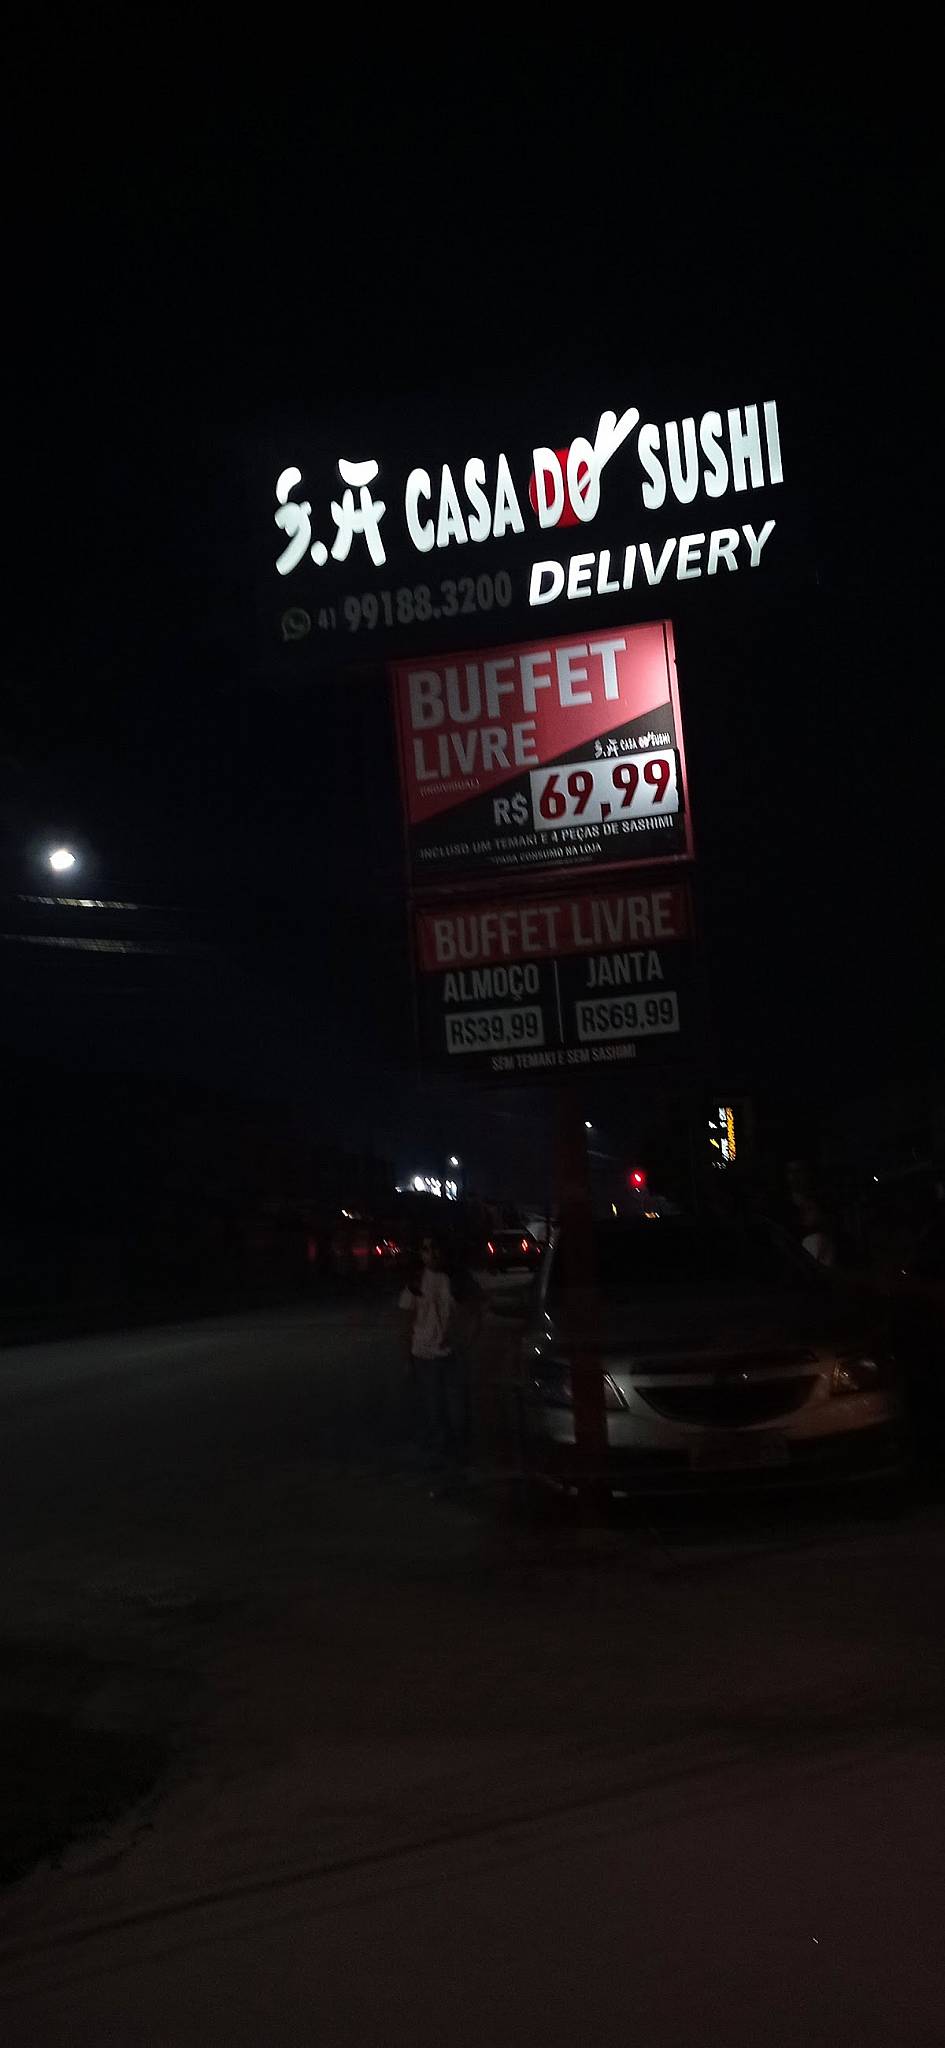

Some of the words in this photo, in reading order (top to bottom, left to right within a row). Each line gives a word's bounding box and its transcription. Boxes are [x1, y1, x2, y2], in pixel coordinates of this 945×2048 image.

[405, 452, 525, 552] CASA
[533, 430, 608, 528] DO
[636, 400, 784, 510] SUSHI
[528, 518, 777, 606] DELIVERY
[343, 570, 512, 632] 99188.3200
[408, 638, 627, 730] BUFFET
[413, 719, 540, 780] LIVRE
[492, 792, 529, 826] R$
[540, 759, 671, 821] 69,99
[540, 831, 548, 845] E
[603, 822, 621, 836] DE
[622, 814, 674, 833] SASHIMI
[433, 907, 560, 962] BUFFET
[571, 891, 676, 948] LIVRE
[443, 963, 541, 1002] ALMOÇO
[586, 950, 664, 989] JANTA
[490, 1055, 515, 1071] SEM
[567, 1048, 591, 1064] SEM
[591, 1043, 637, 1062] SASHIMI
